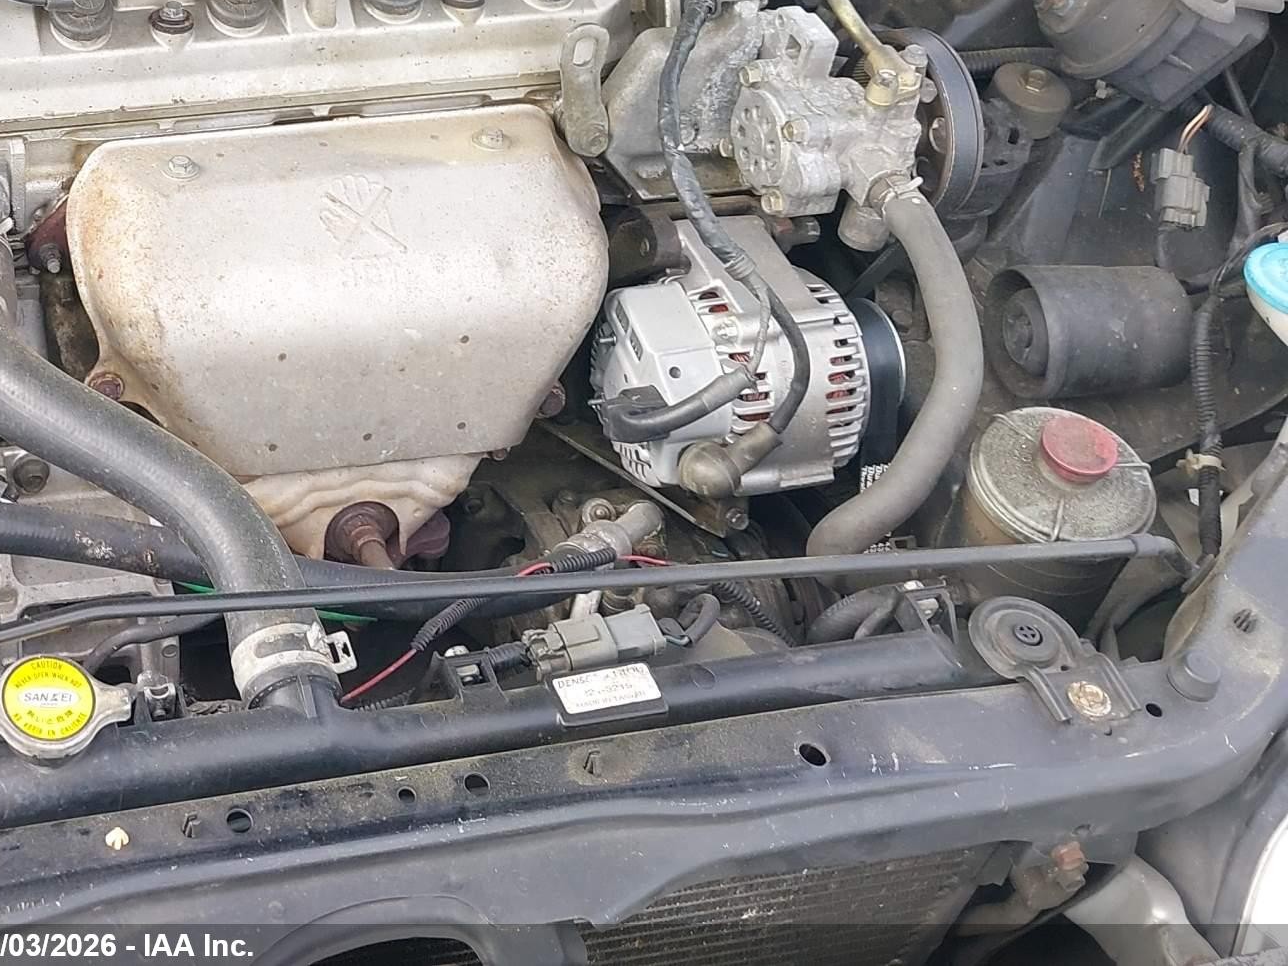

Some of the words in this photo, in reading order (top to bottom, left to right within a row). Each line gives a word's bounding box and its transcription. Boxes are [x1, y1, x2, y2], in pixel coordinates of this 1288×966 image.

[31, 660, 63, 670] CAUTION
[15, 676, 32, 688] NEVER
[33, 671, 49, 680] OPEN
[52, 671, 69, 682] WHEN
